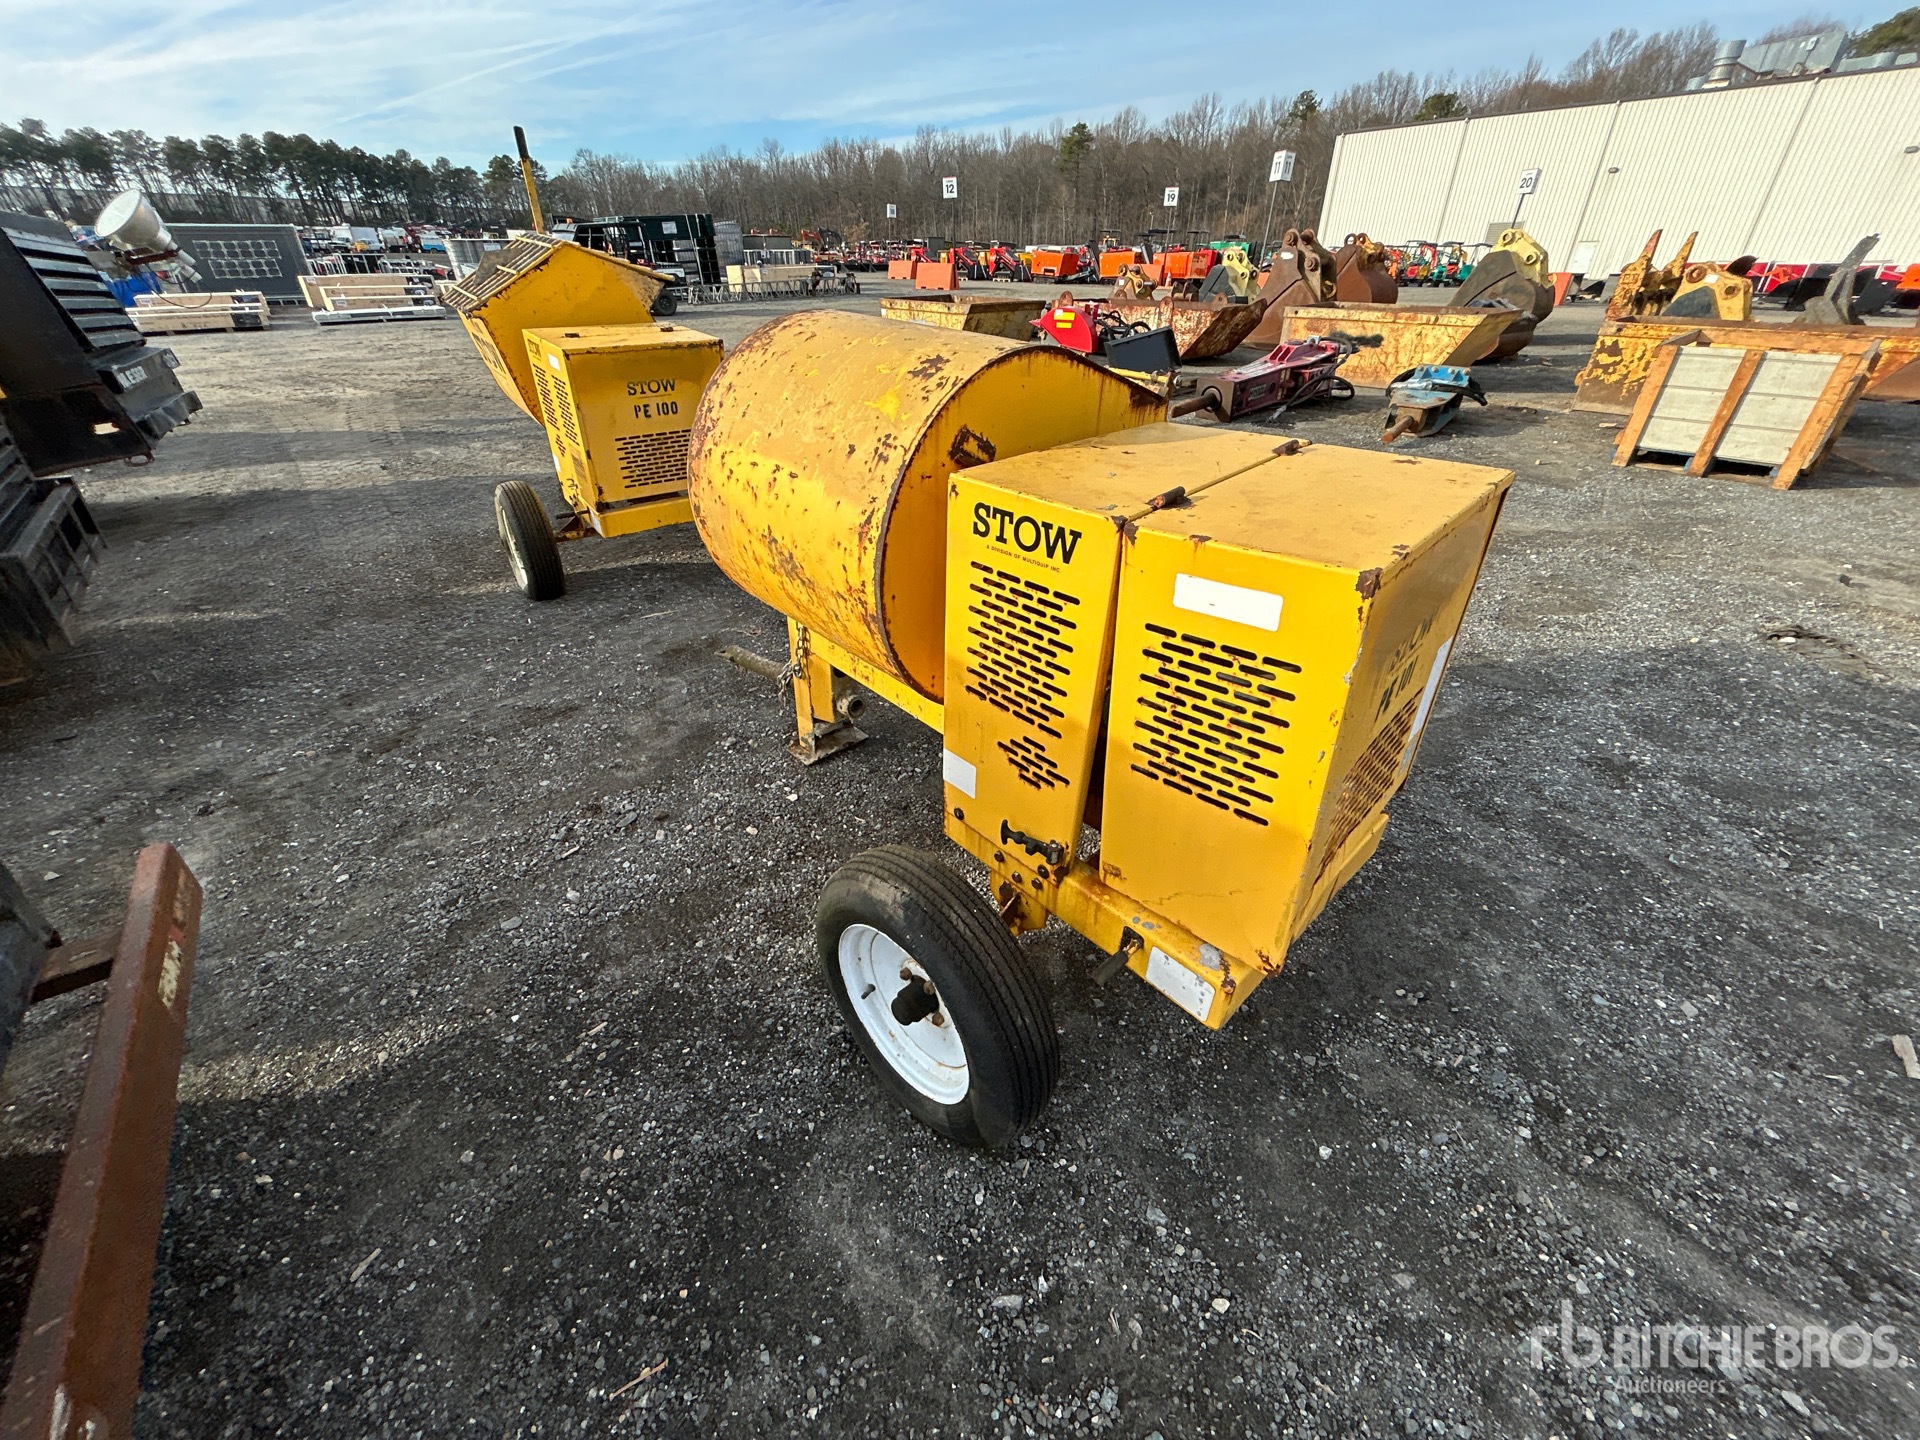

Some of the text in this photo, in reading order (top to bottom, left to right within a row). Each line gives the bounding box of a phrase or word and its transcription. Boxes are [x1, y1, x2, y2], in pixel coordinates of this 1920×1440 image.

[945, 183, 954, 193] 12
[1519, 177, 1532, 188] 20
[1167, 193, 1176, 202] 19
[627, 379, 676, 396] STOW
[634, 401, 678, 418] PE 100
[973, 502, 1082, 564] STOW
[991, 546, 1012, 557] DIVISION
[1022, 556, 1049, 569] MULTIQUIP
